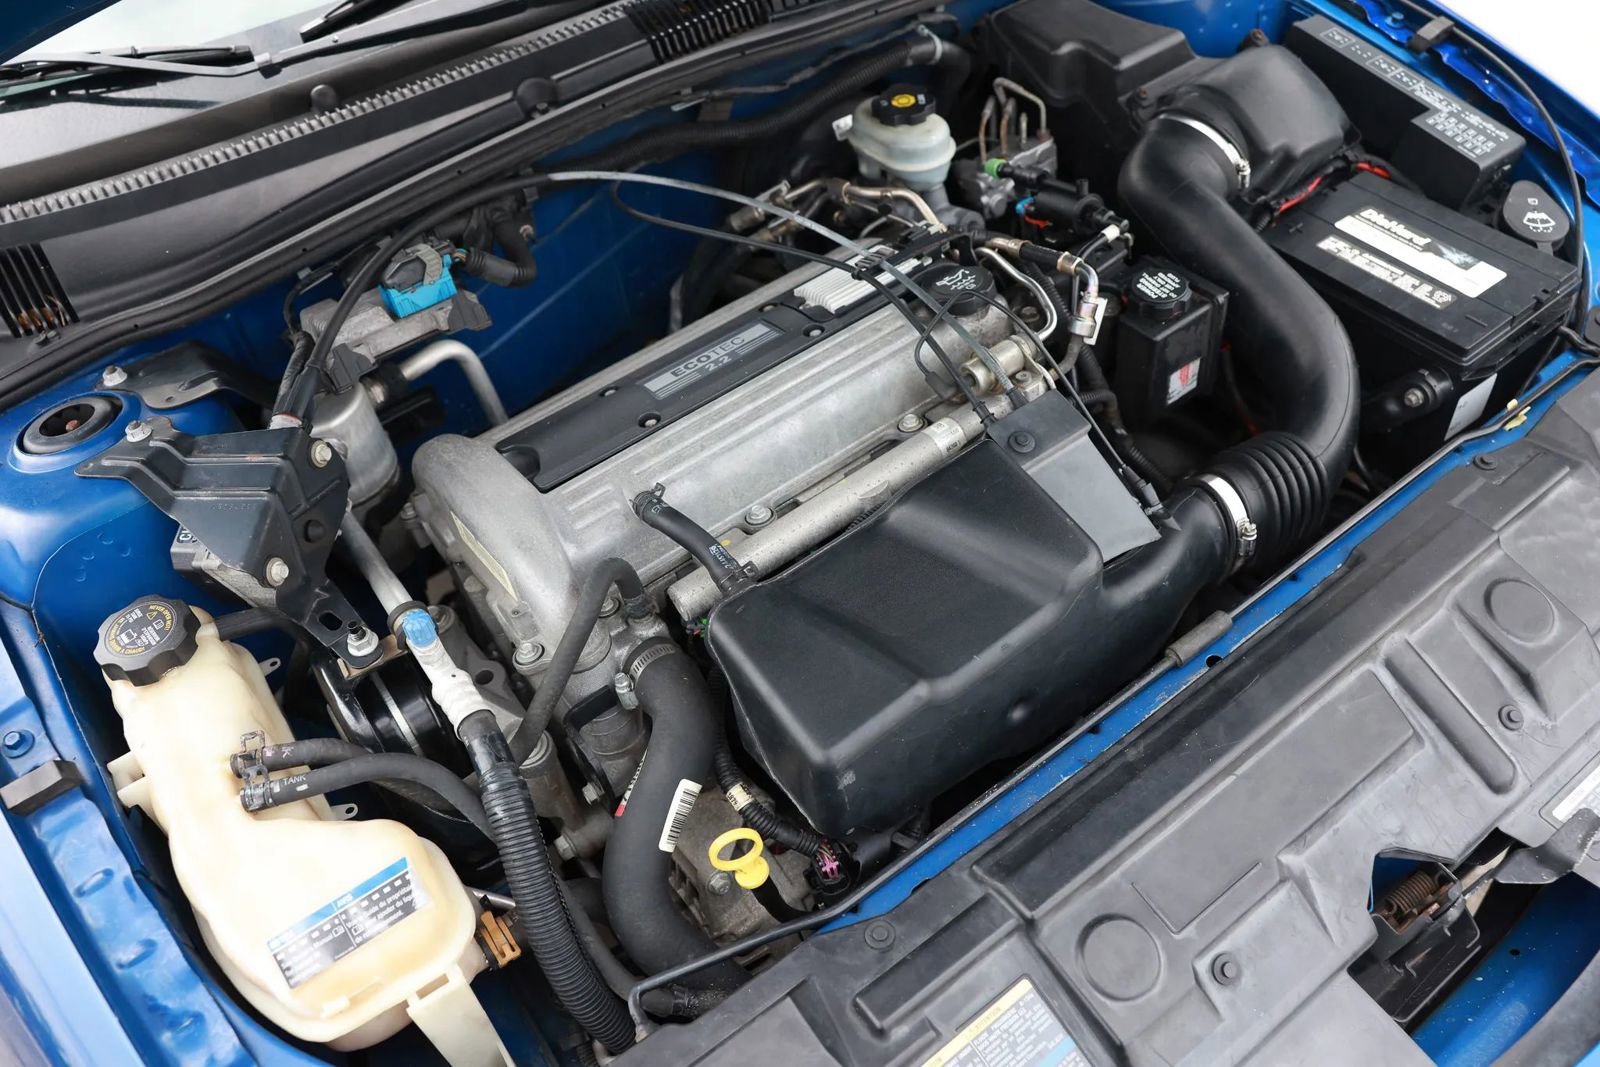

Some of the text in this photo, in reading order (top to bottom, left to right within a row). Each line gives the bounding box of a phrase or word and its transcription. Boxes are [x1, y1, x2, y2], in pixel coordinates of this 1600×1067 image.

[1136, 283, 1158, 299] POWER
[671, 337, 744, 377] ECOTEC
[705, 356, 731, 371] 2.2
[283, 774, 307, 786] TANK
